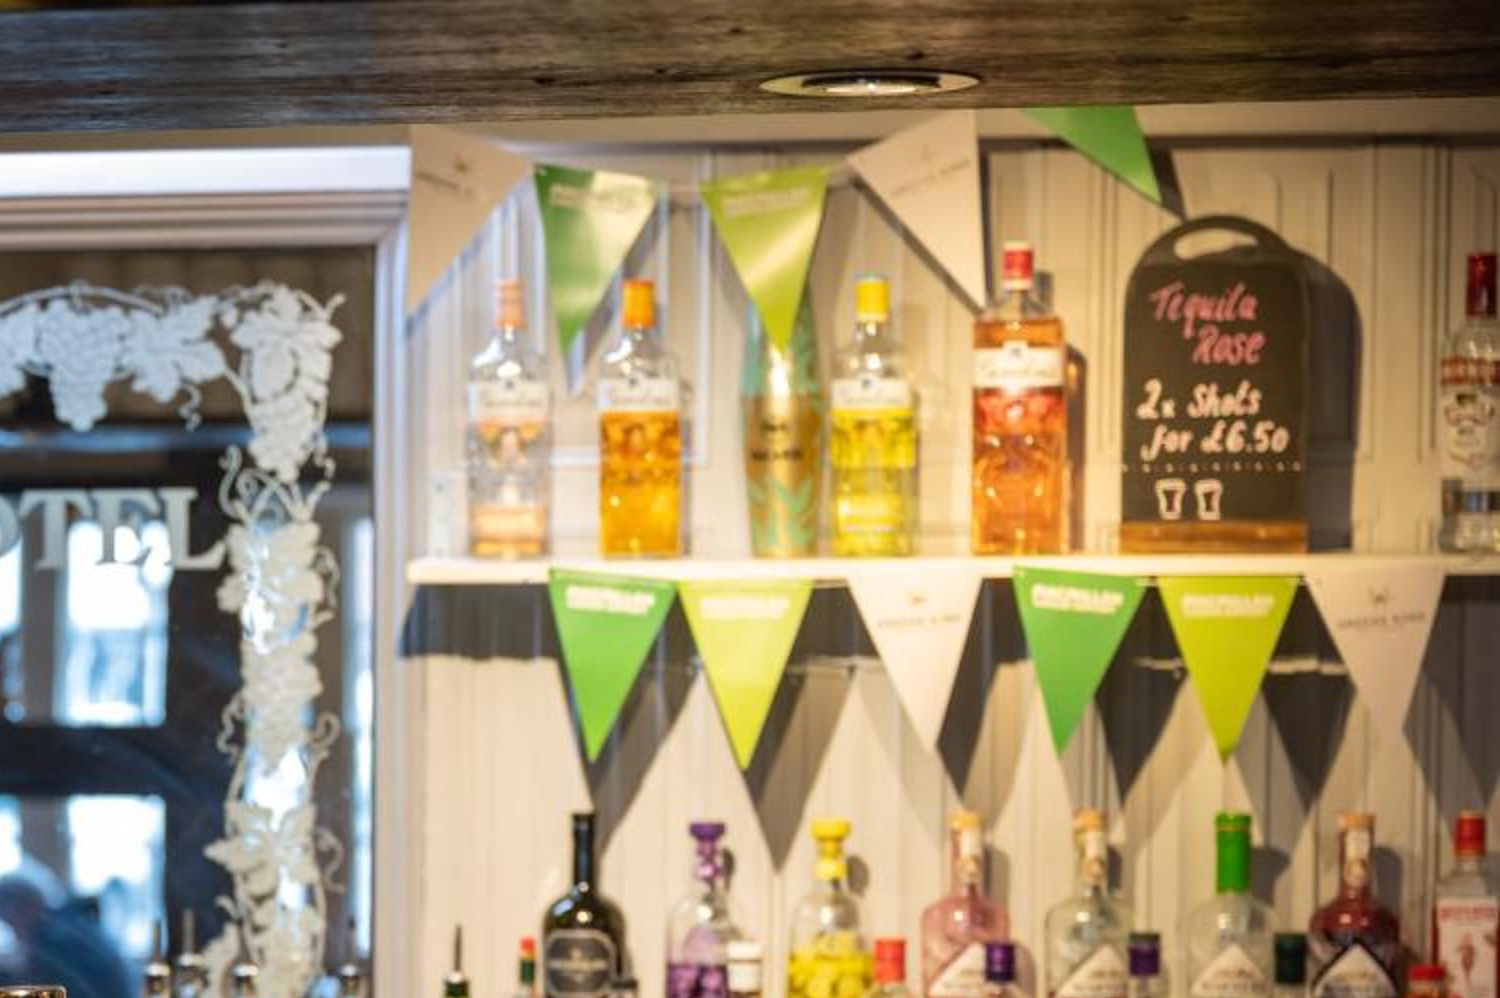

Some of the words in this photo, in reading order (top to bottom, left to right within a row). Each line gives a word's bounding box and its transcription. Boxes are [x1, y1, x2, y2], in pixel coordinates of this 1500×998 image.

[1151, 279, 1258, 339] Tequila
[1192, 323, 1266, 365] Rose
[1187, 379, 1263, 418] Shots
[1140, 424, 1194, 462] for
[1200, 419, 1291, 454] £6.50
